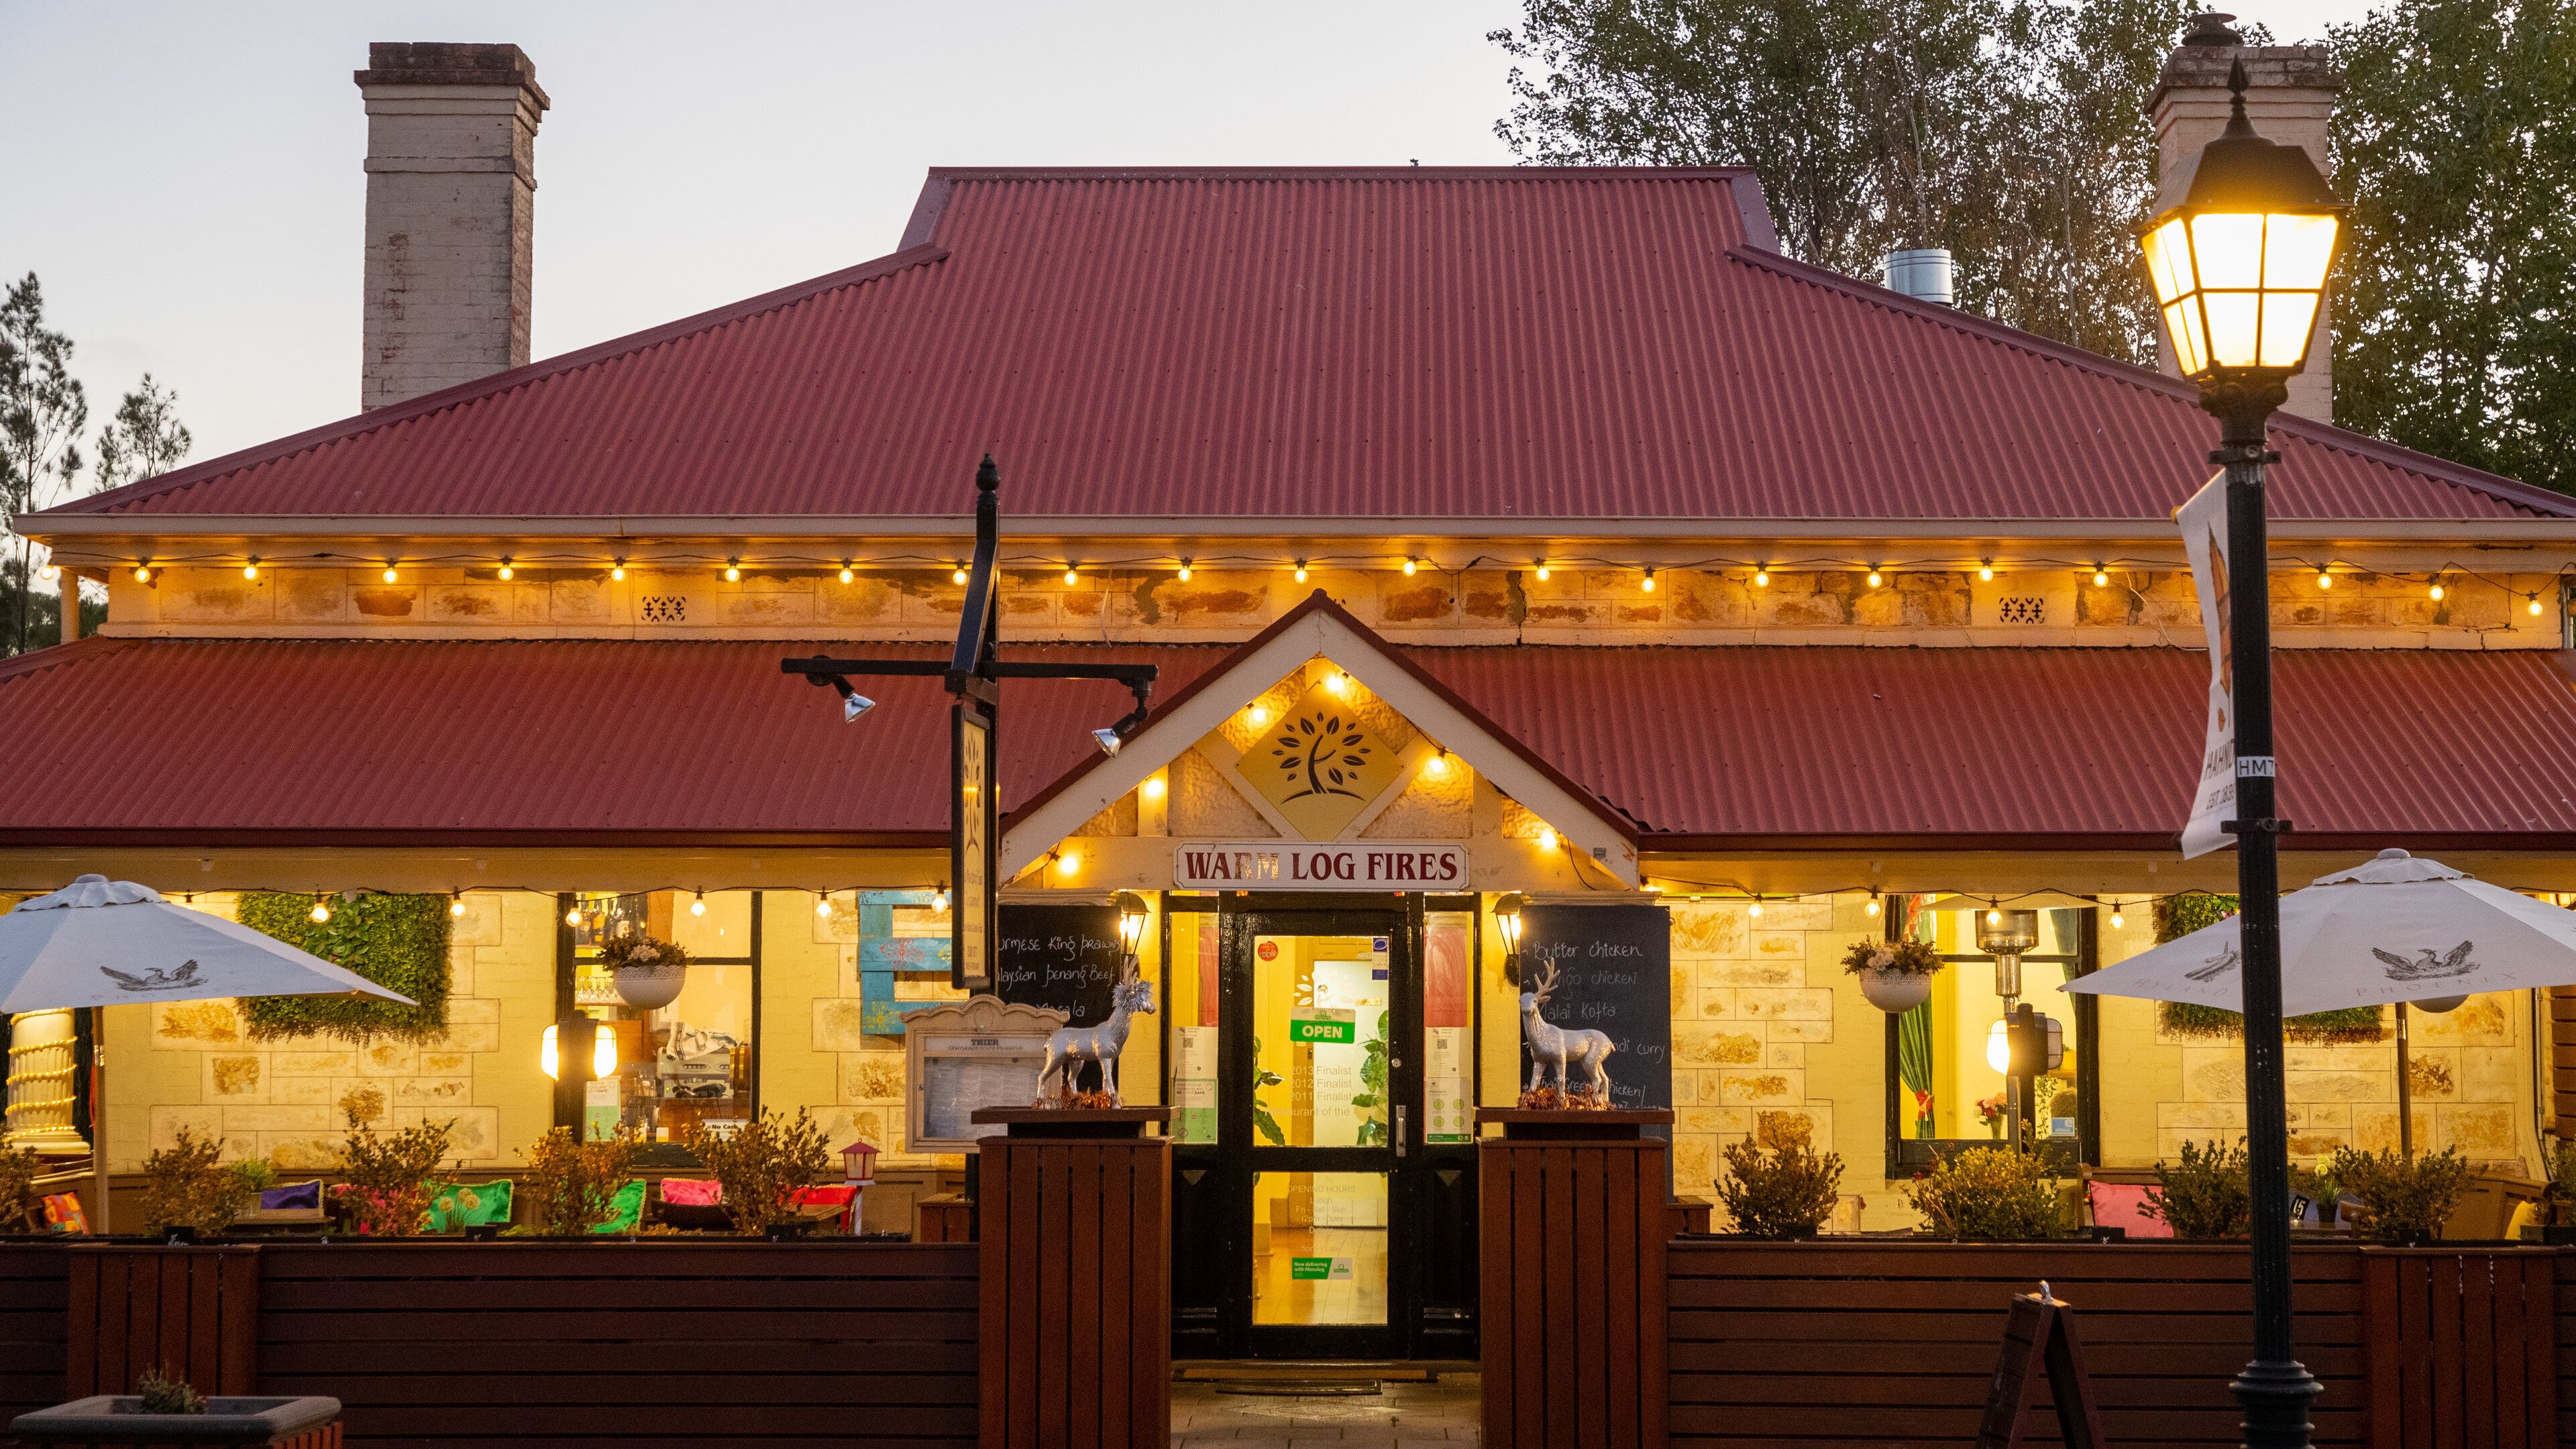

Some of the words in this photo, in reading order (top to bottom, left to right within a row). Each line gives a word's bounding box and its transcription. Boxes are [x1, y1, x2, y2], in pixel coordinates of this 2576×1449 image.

[2204, 738, 2235, 782] HAHND
[1185, 852, 1279, 880] WARM
[1291, 852, 1356, 880] LOG
[1366, 852, 1458, 881] FIRES
[998, 938, 1040, 955] urmese
[1047, 935, 1076, 961] King
[1534, 941, 1578, 961] Butter
[1589, 941, 1644, 958] chicken
[998, 966, 1036, 992] laysian
[2356, 973, 2516, 996] PHOENIX
[1302, 1025, 1342, 1038] OPEN
[1636, 1042, 1666, 1064] curry
[1291, 1065, 1313, 1075] 2013
[1316, 1065, 1352, 1075] Finalist
[1290, 1079, 1313, 1088] 2012
[1317, 1079, 1352, 1088] Finalist
[1290, 1091, 1313, 1101] 2011
[1317, 1091, 1352, 1101] Finalist
[1322, 1107, 1332, 1116] of
[1334, 1107, 1350, 1116] the
[2293, 1199, 2306, 1216] 15
